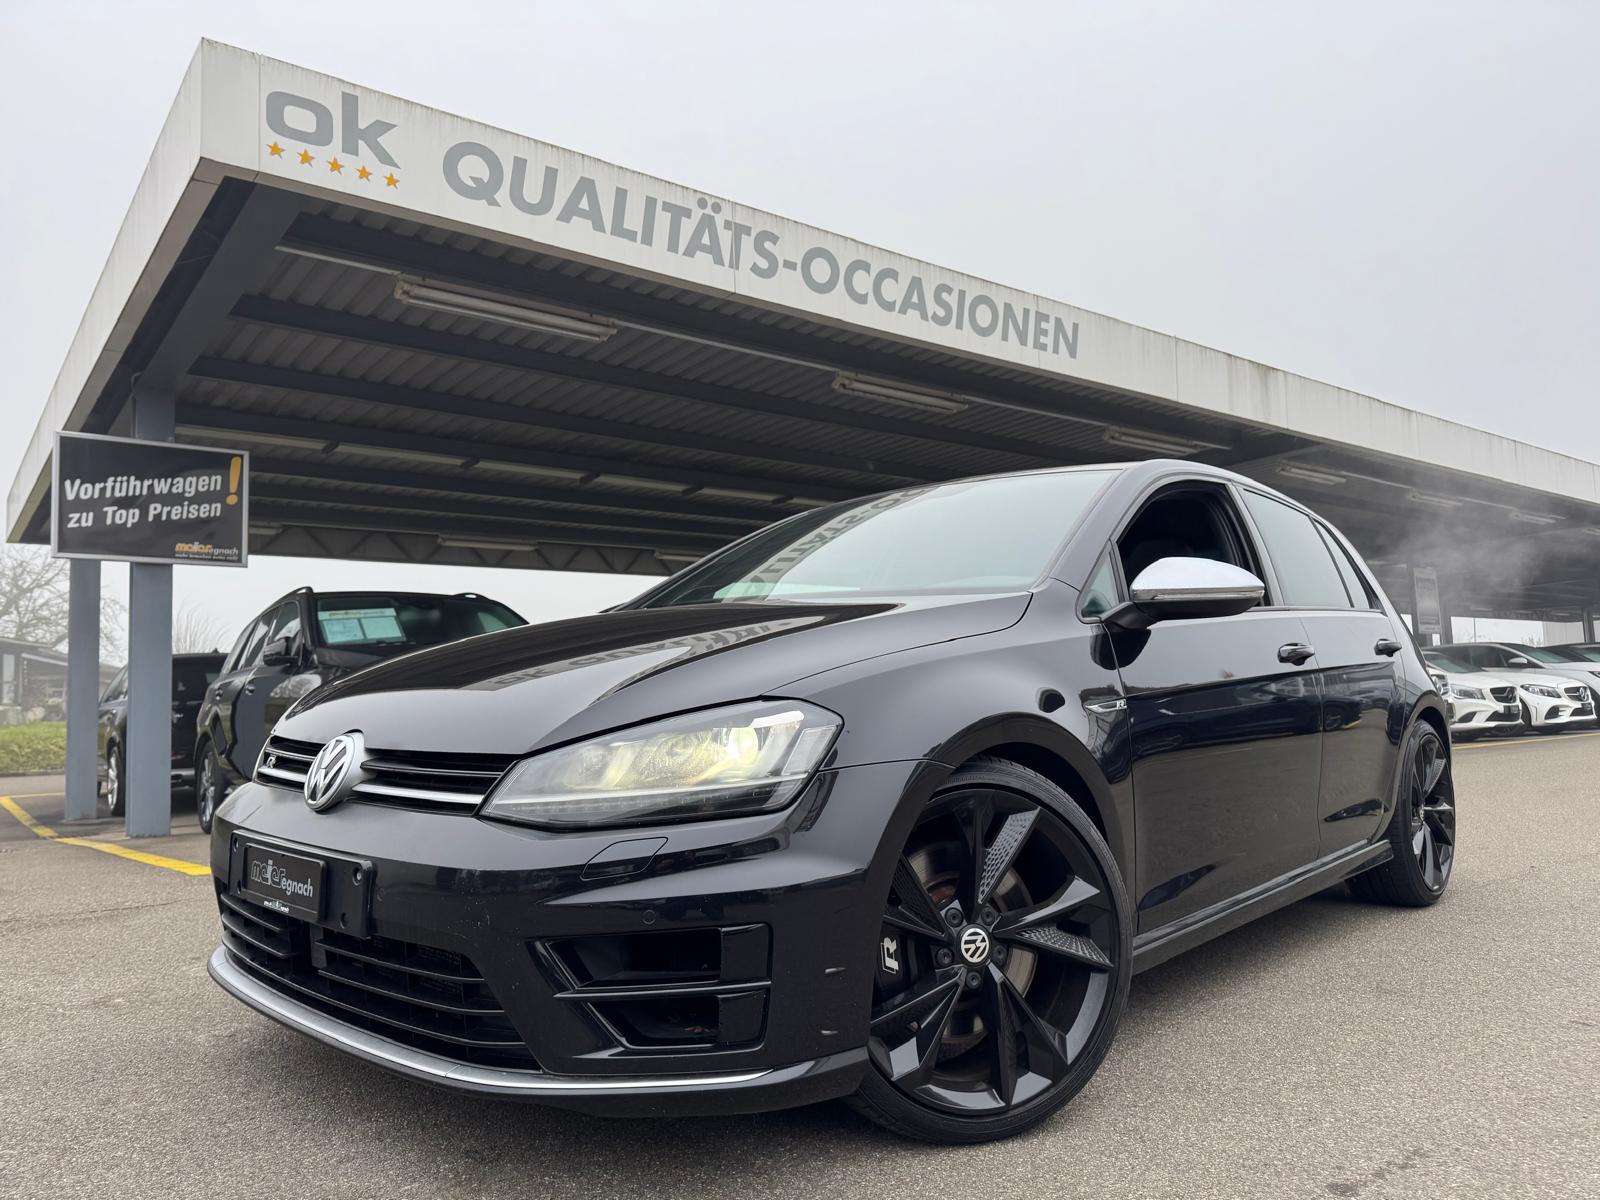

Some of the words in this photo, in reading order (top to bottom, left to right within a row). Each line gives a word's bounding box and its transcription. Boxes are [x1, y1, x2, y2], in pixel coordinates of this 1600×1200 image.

[266, 91, 401, 169] ok
[443, 141, 1079, 359] QUALITÄTS-OCCASIONEN
[64, 474, 222, 501] Vorführwagen
[67, 512, 93, 529] zu
[103, 506, 140, 528] Top
[148, 501, 222, 522] Preisen
